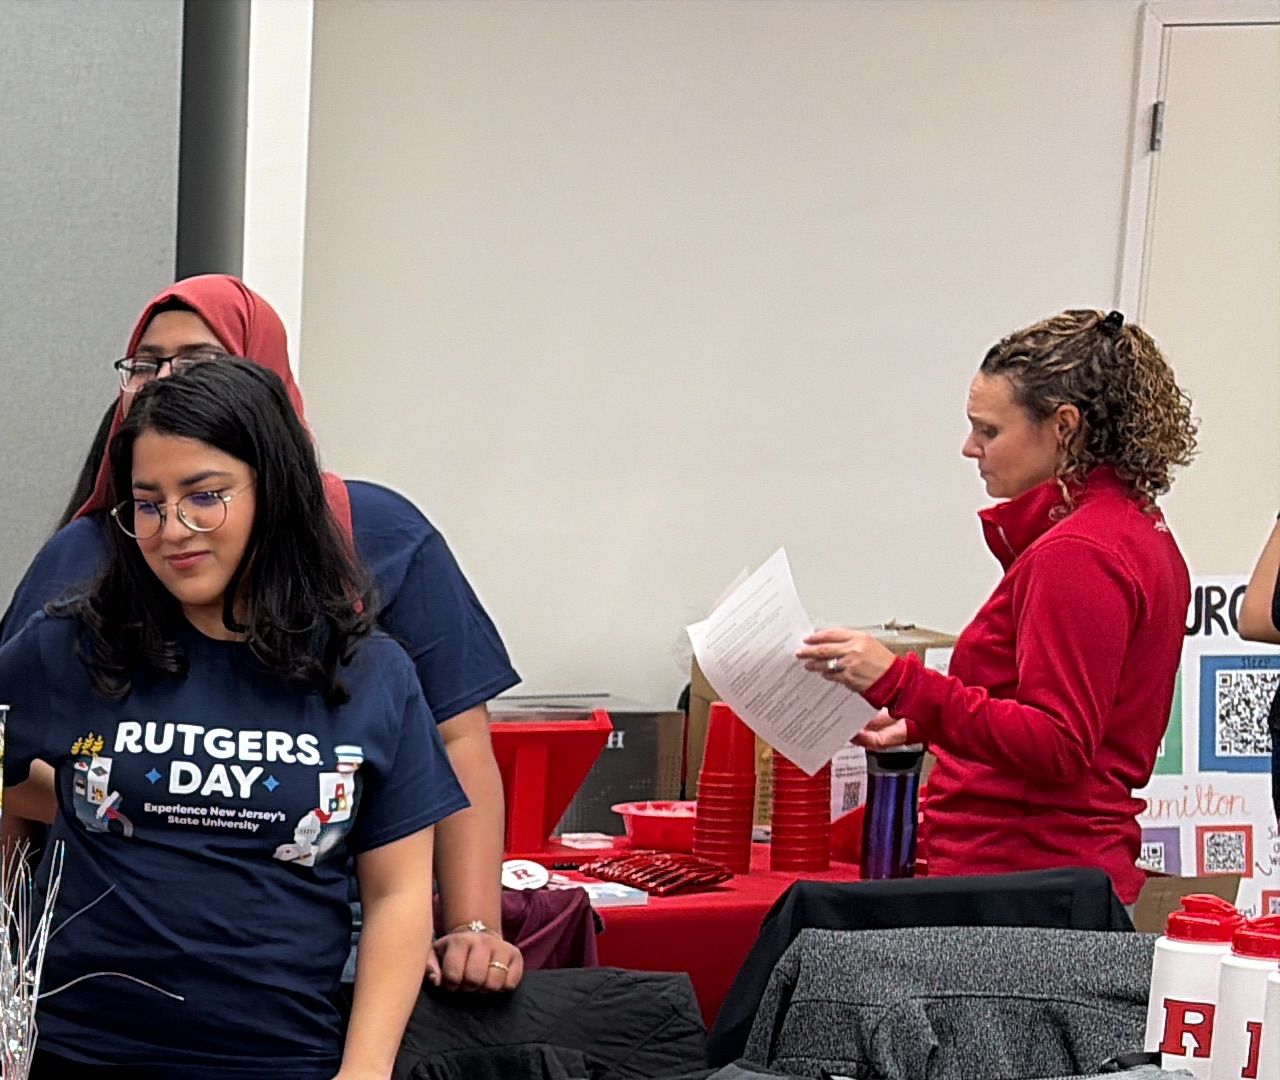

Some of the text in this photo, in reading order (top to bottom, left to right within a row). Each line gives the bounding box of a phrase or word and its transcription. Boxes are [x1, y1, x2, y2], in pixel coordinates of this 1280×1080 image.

[114, 721, 322, 766] RUTGERS
[169, 760, 264, 799] DAY
[144, 802, 286, 823] Experience New Jersey's
[1139, 784, 1249, 820] amilton
[167, 815, 259, 833] State University
[1159, 998, 1216, 1058] R
